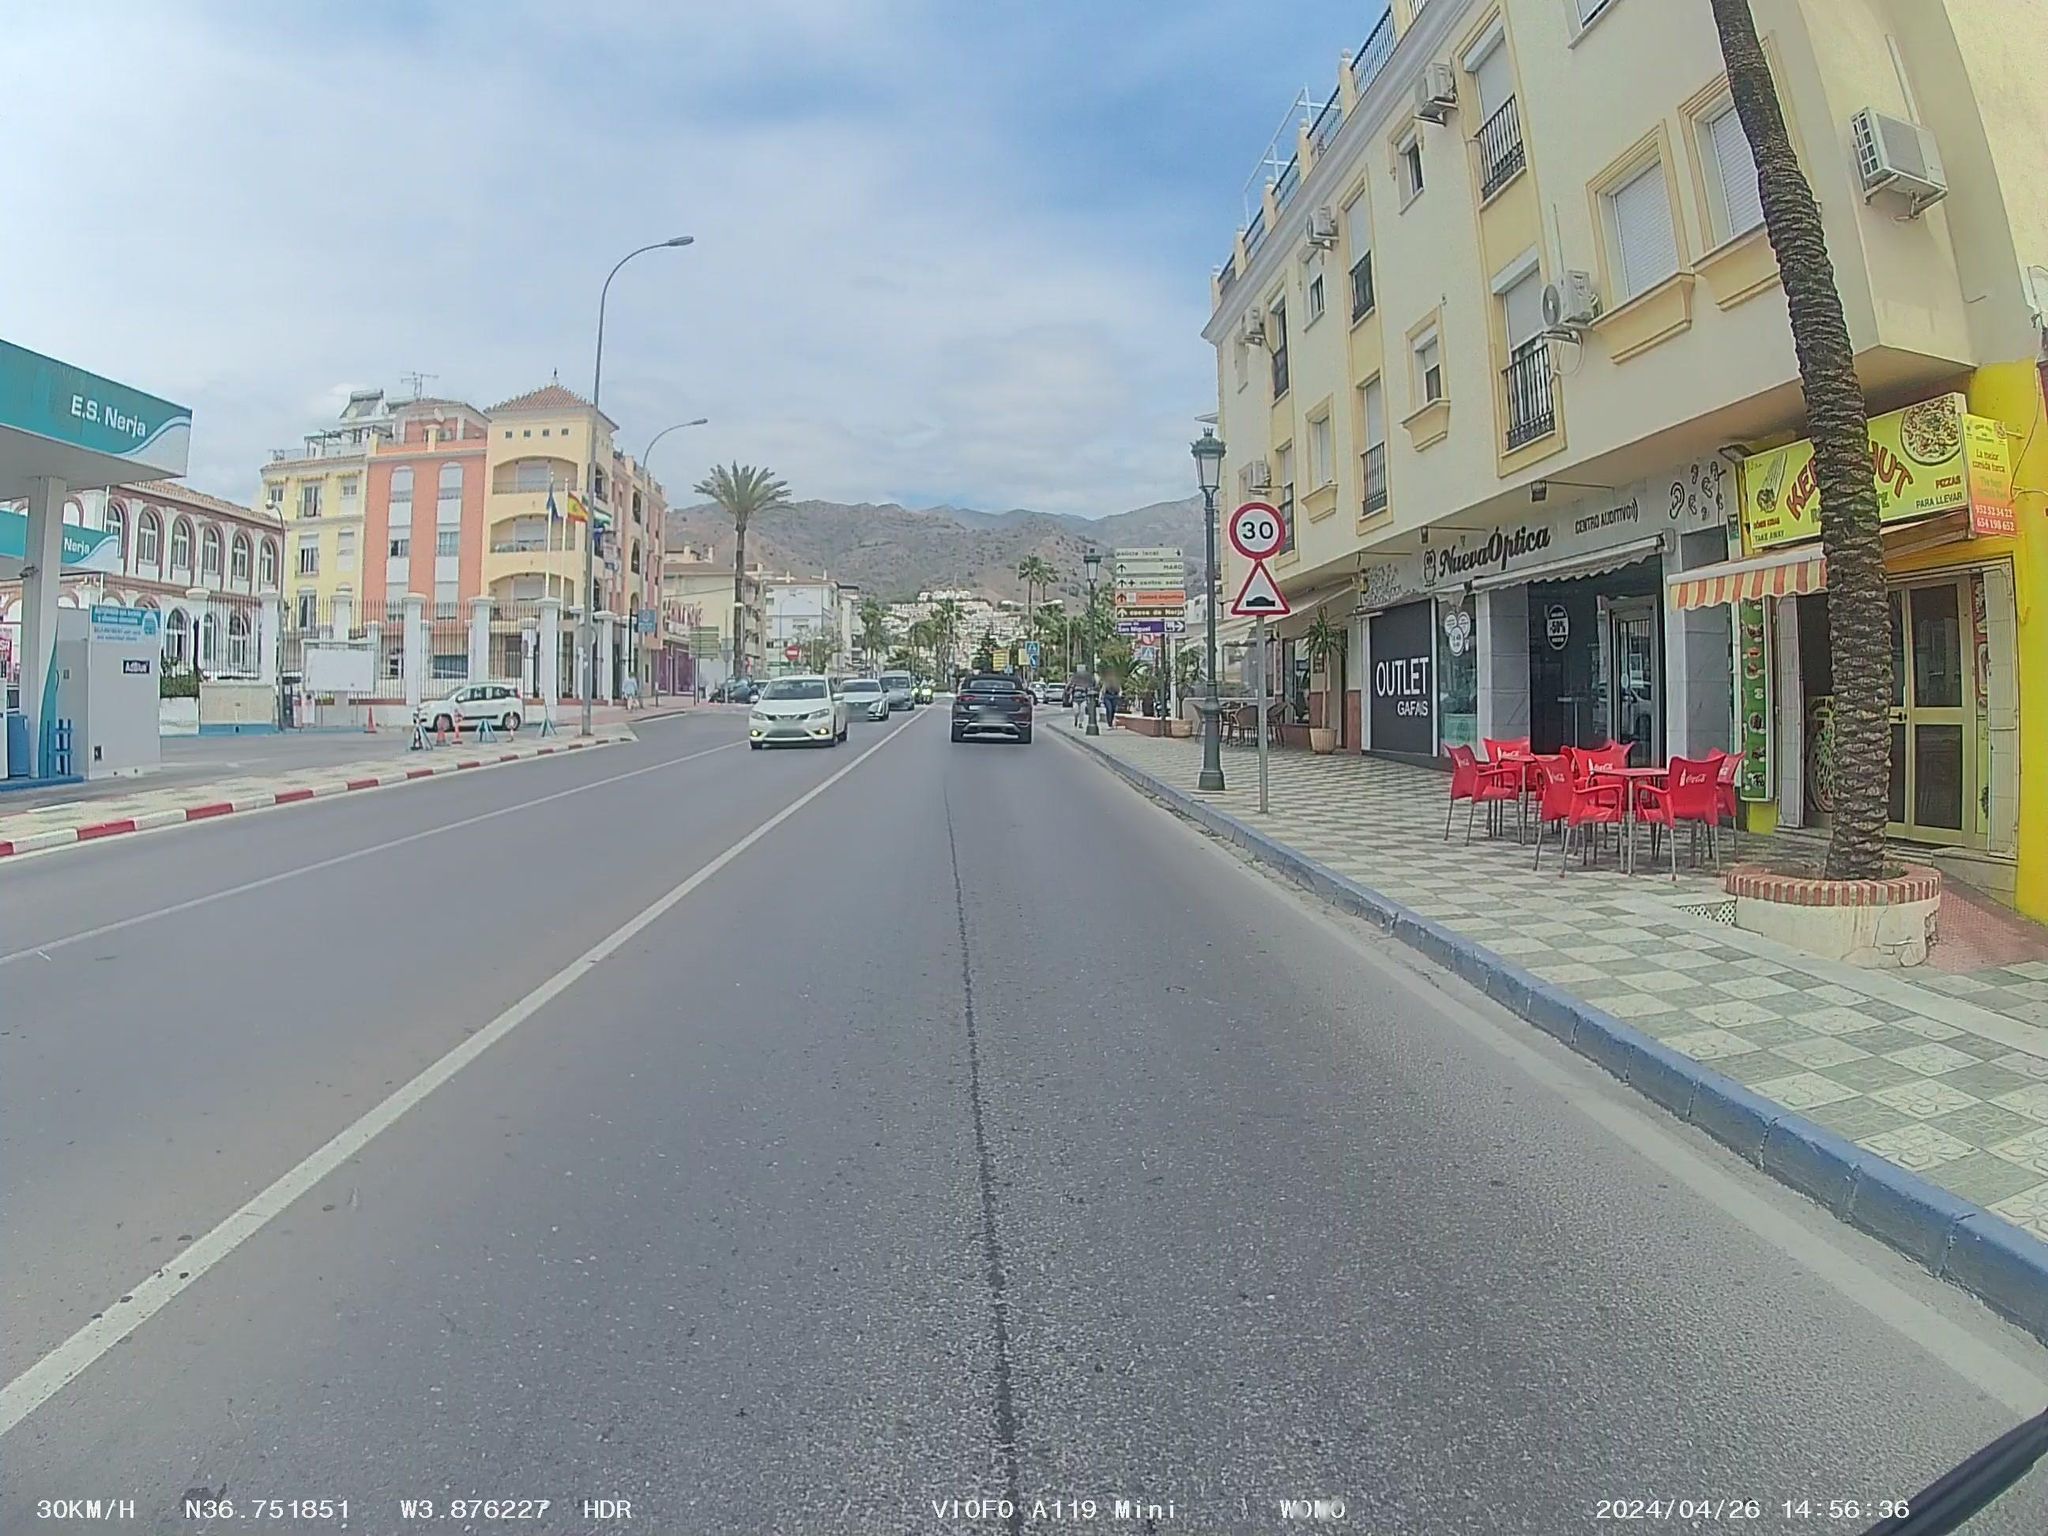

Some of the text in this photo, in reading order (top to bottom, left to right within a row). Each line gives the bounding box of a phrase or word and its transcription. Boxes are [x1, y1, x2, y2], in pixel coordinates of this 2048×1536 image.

[71, 394, 147, 439] E.S. Nerja
[1935, 475, 1962, 489] PIZZAS
[1915, 497, 1935, 509] PARA
[1935, 491, 1963, 505] LLEVAR
[1575, 504, 1632, 535] CENTRO AUDITIVO
[1241, 521, 1274, 540] 30
[1164, 608, 1184, 617] Nerja
[1376, 656, 1429, 697] OUTLET
[1397, 700, 1429, 717] GAFAS
